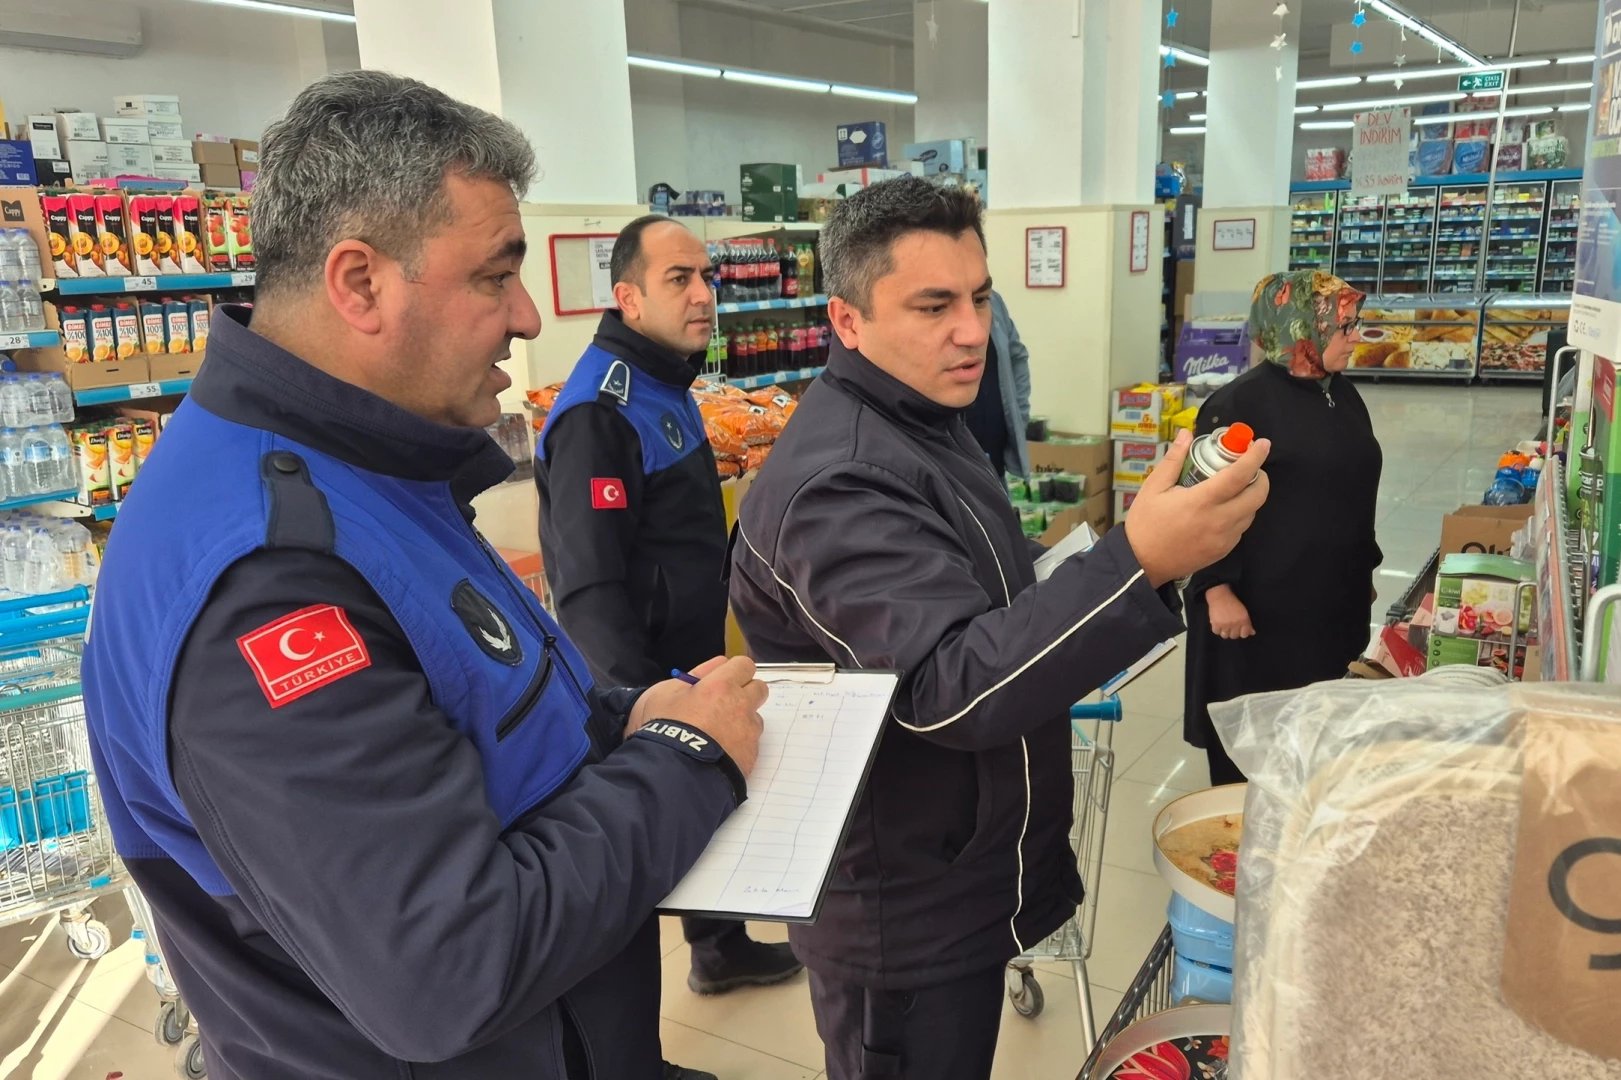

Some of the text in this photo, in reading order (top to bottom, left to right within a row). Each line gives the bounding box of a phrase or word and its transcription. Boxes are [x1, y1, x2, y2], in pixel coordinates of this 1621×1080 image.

[1367, 110, 1394, 127] DEV
[4, 206, 21, 217] Cappy
[50, 214, 67, 222] Cappy
[104, 214, 121, 222] Cappy
[141, 278, 152, 286] 45
[10, 336, 21, 345] 28
[1183, 352, 1230, 376] Milka
[146, 385, 157, 393] 55
[279, 652, 356, 692] TÜRKİYE
